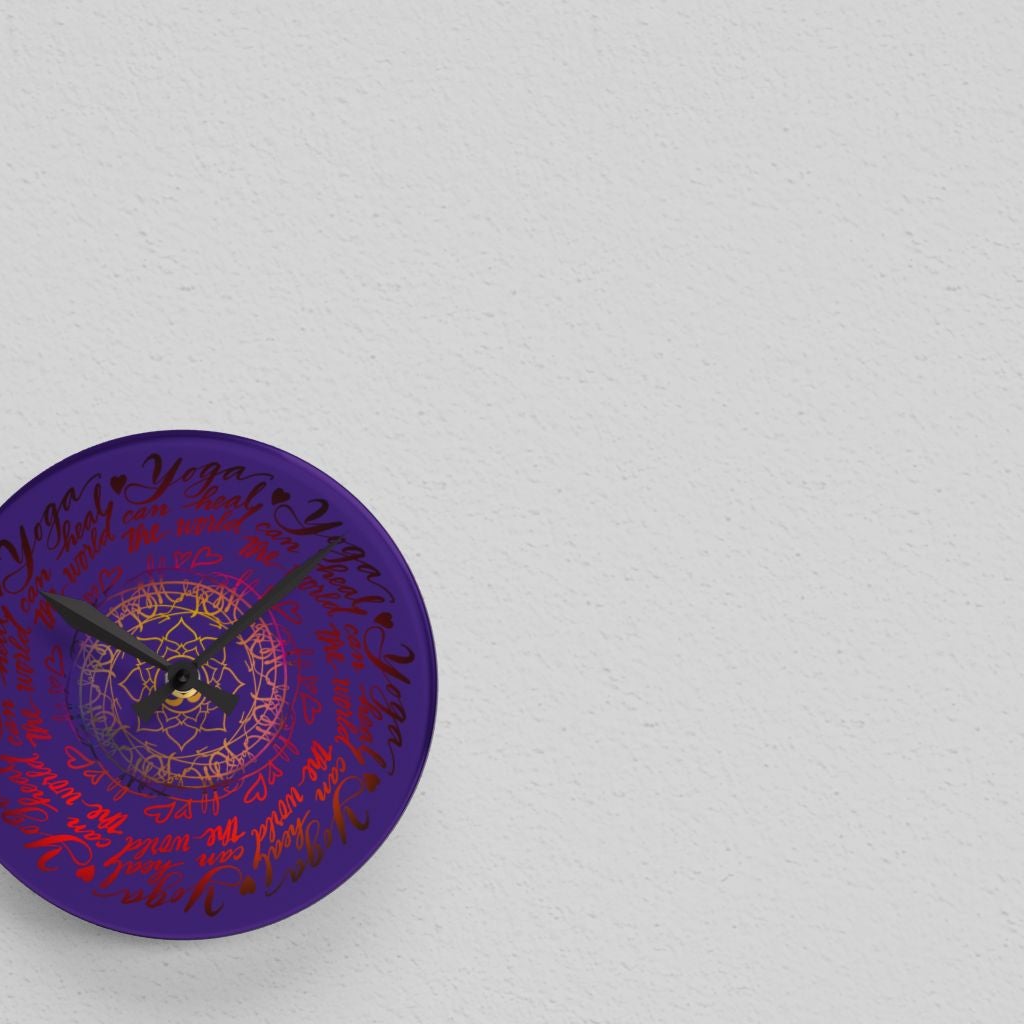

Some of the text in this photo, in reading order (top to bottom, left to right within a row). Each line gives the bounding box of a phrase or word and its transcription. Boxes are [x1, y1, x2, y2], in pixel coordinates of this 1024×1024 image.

[120, 480, 266, 524] can heal
[123, 451, 274, 506] Yoga
[174, 502, 263, 537] world
[18, 481, 107, 613] can heal
[60, 499, 115, 584] world
[253, 520, 385, 609] can heal
[271, 496, 395, 603] Yoga
[0, 603, 35, 692] world
[0, 696, 22, 746] can
[329, 676, 364, 765] world
[342, 622, 386, 768] can heal
[360, 625, 415, 776] Yoga
[65, 815, 111, 848] can
[101, 831, 190, 866] world
[249, 784, 304, 869] world
[257, 755, 346, 887] can heal
[263, 773, 370, 897] Yoga
[90, 862, 241, 917] Yoga
[98, 844, 244, 888] can heal
